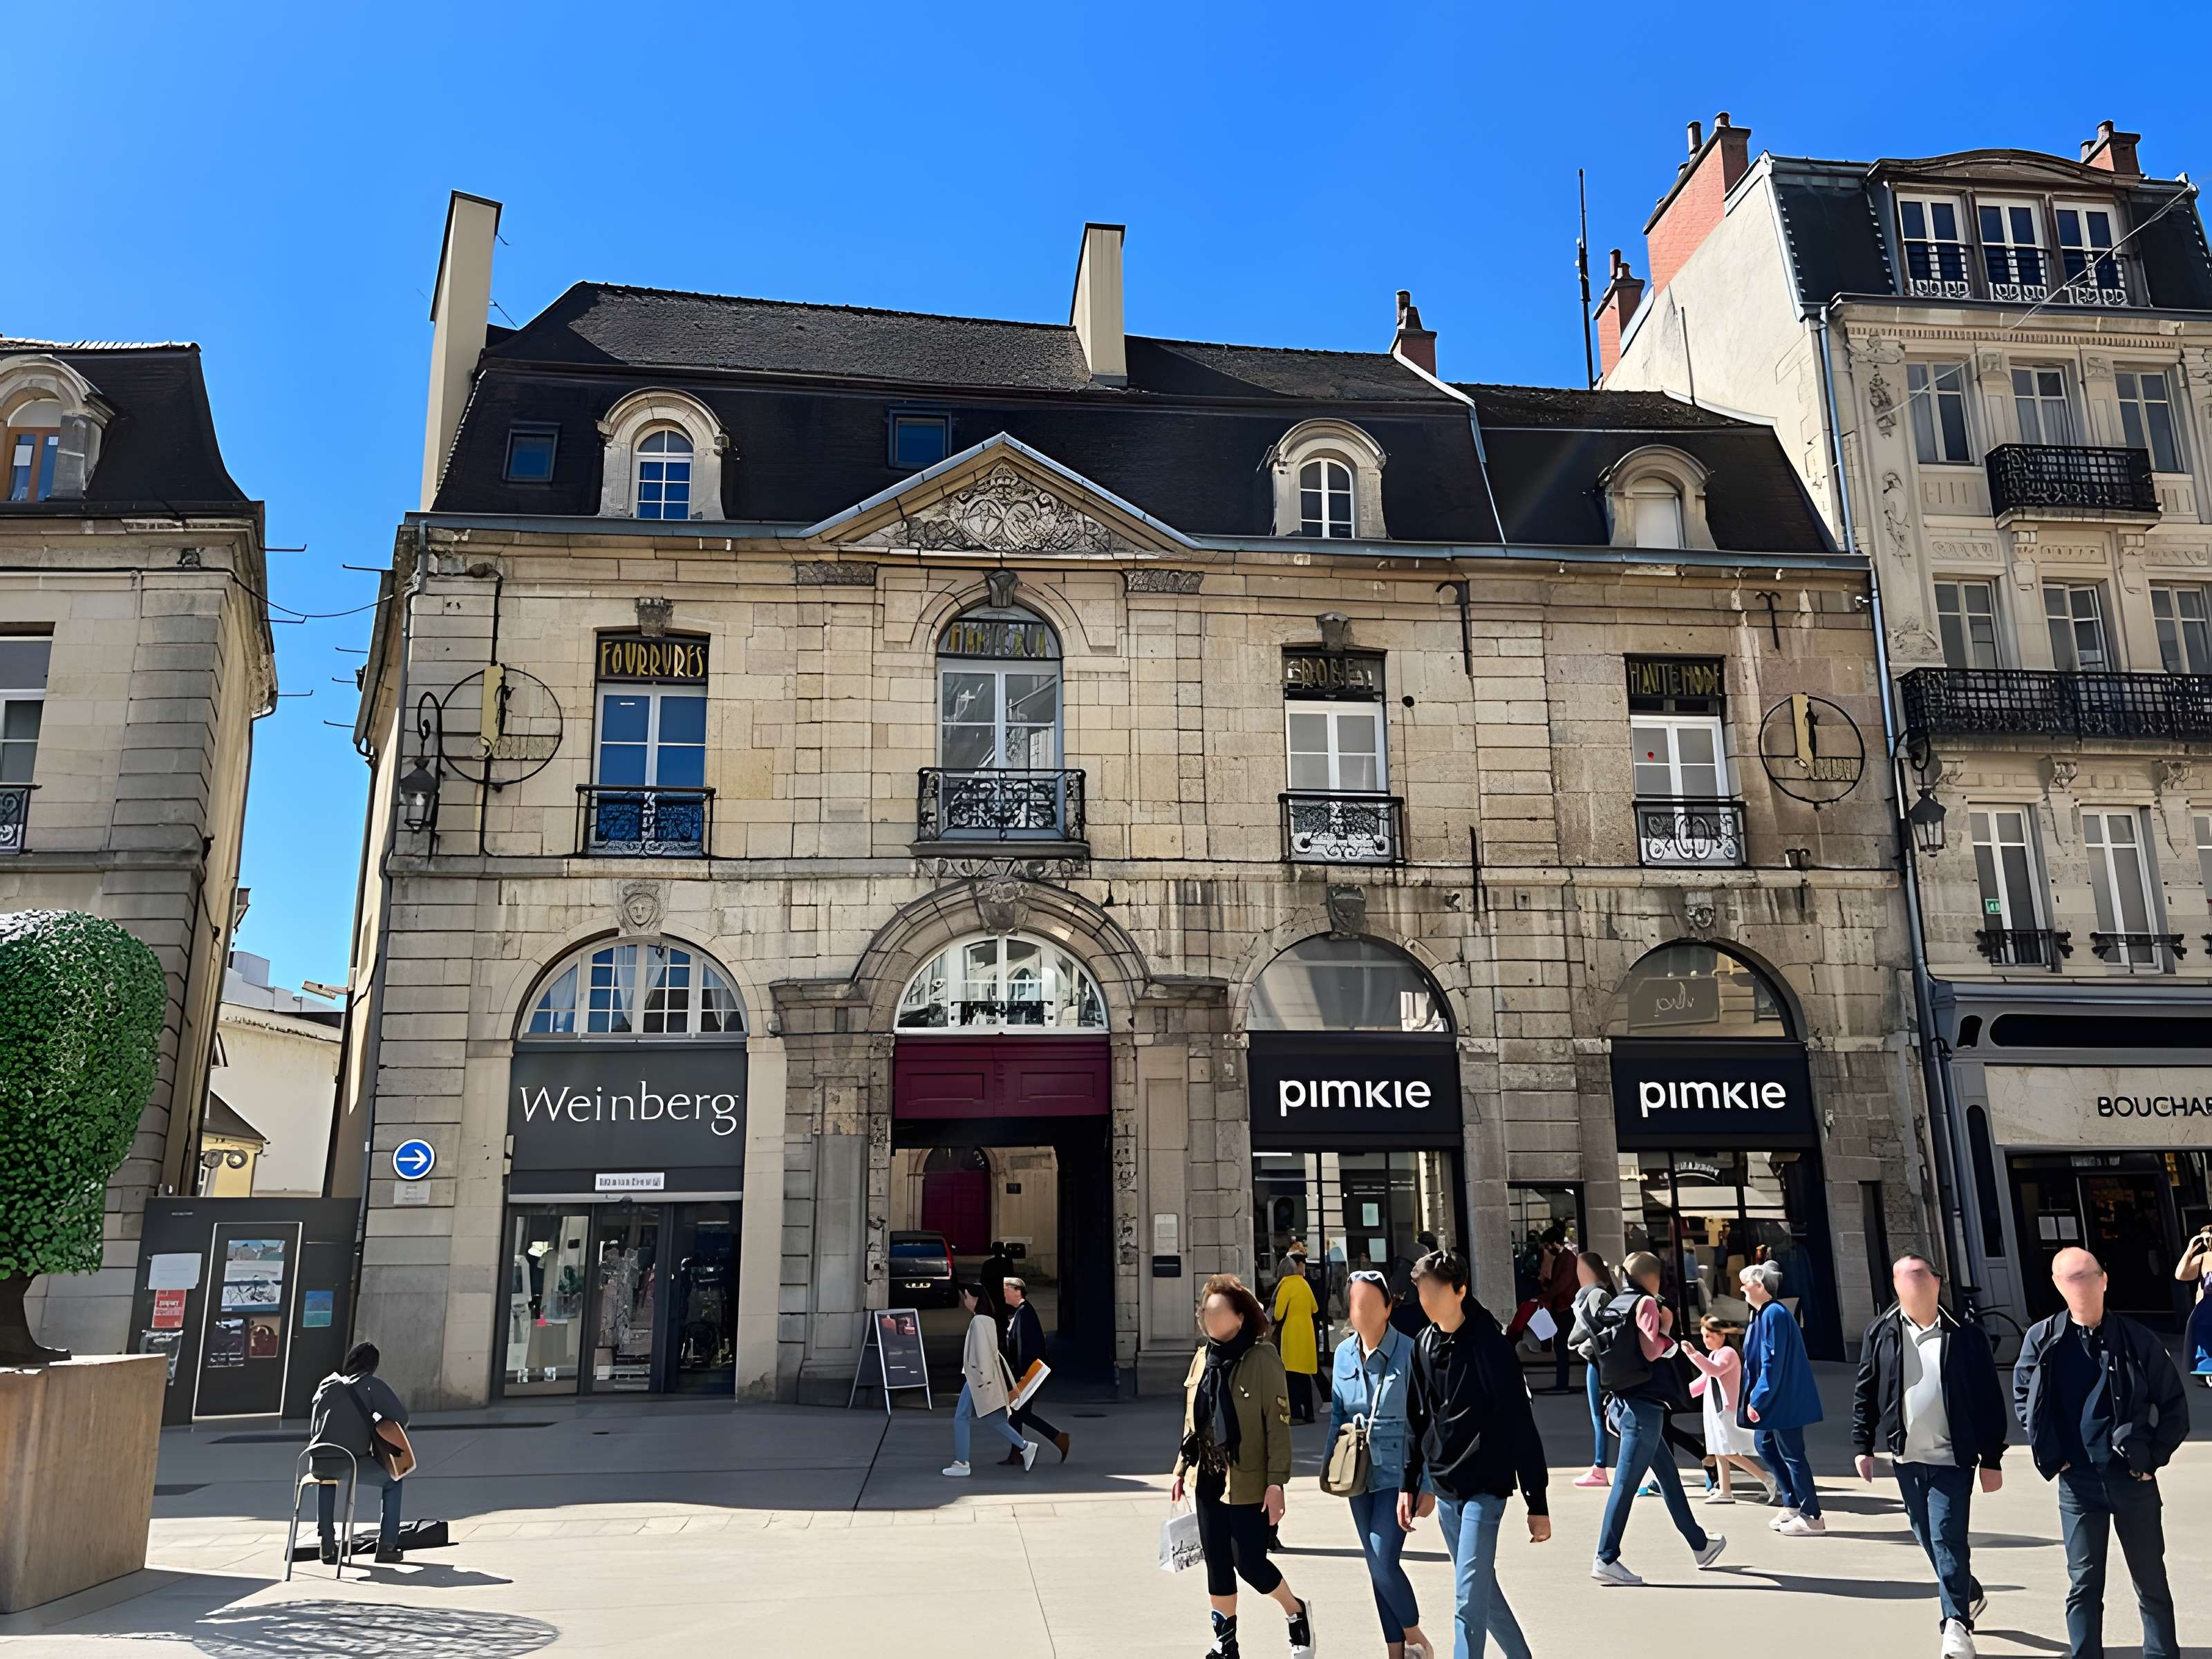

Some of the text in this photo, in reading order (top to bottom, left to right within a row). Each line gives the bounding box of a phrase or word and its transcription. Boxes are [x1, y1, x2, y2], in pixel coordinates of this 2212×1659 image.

[600, 641, 706, 678] FOURRURES
[520, 1080, 739, 1136] Weinberg
[1279, 1080, 1432, 1117] pimkie
[1639, 1081, 1786, 1118] pimkie
